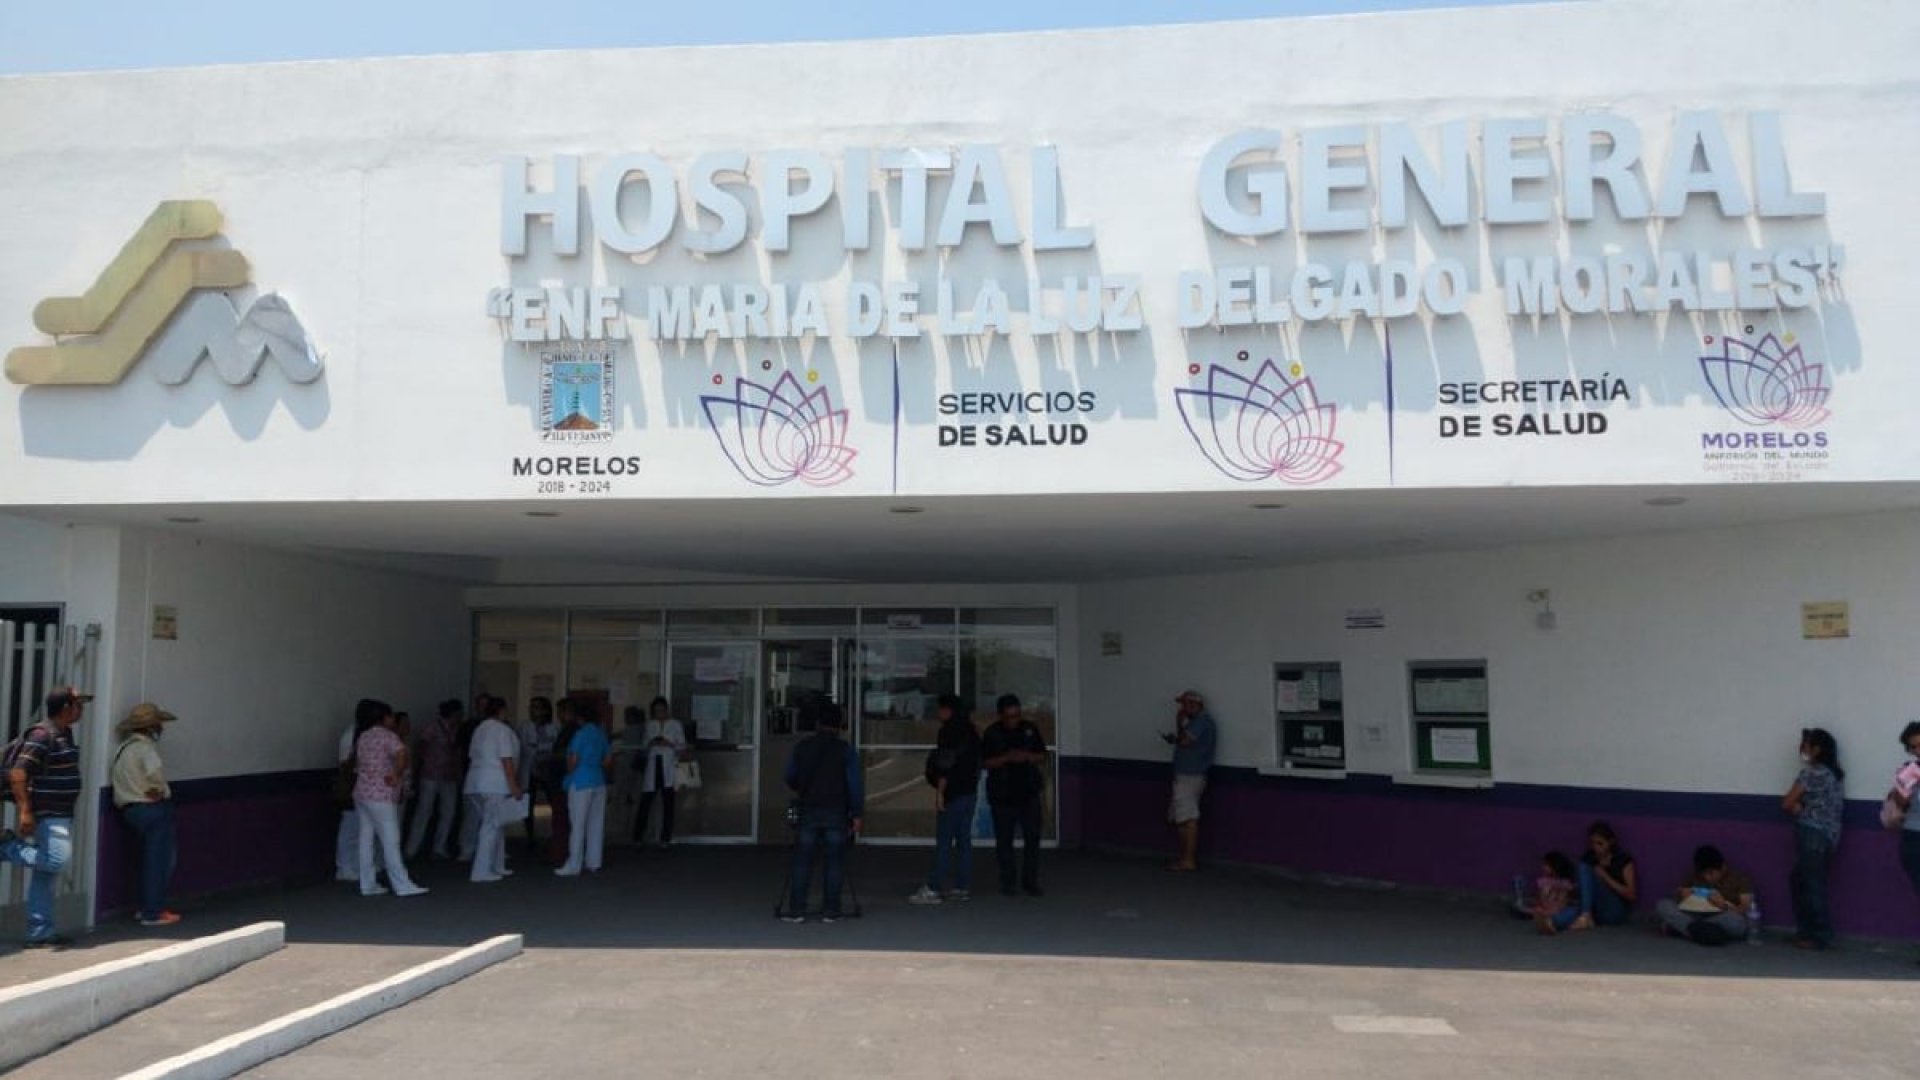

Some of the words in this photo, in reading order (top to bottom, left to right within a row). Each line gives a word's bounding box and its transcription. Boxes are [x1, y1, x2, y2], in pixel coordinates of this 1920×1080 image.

[500, 144, 1095, 256] HOSPITAL
[1197, 108, 1827, 236] GENERAL
[650, 282, 831, 339] MARIA
[847, 280, 921, 337] DE
[937, 278, 1010, 336] LA
[1028, 273, 1144, 334] LUZ
[1177, 258, 1468, 328] DELGADO
[1439, 371, 1631, 404] SECRETARÍA
[938, 391, 1097, 415] SERVICIOS
[938, 425, 976, 446] DE
[985, 423, 1089, 446] SALUD
[1439, 415, 1481, 438] DE
[1492, 412, 1608, 436] SALUD
[1701, 432, 1829, 449] MORELOS
[512, 456, 641, 476] MORELOS
[538, 481, 565, 494] 2018
[579, 481, 611, 493] 2024
